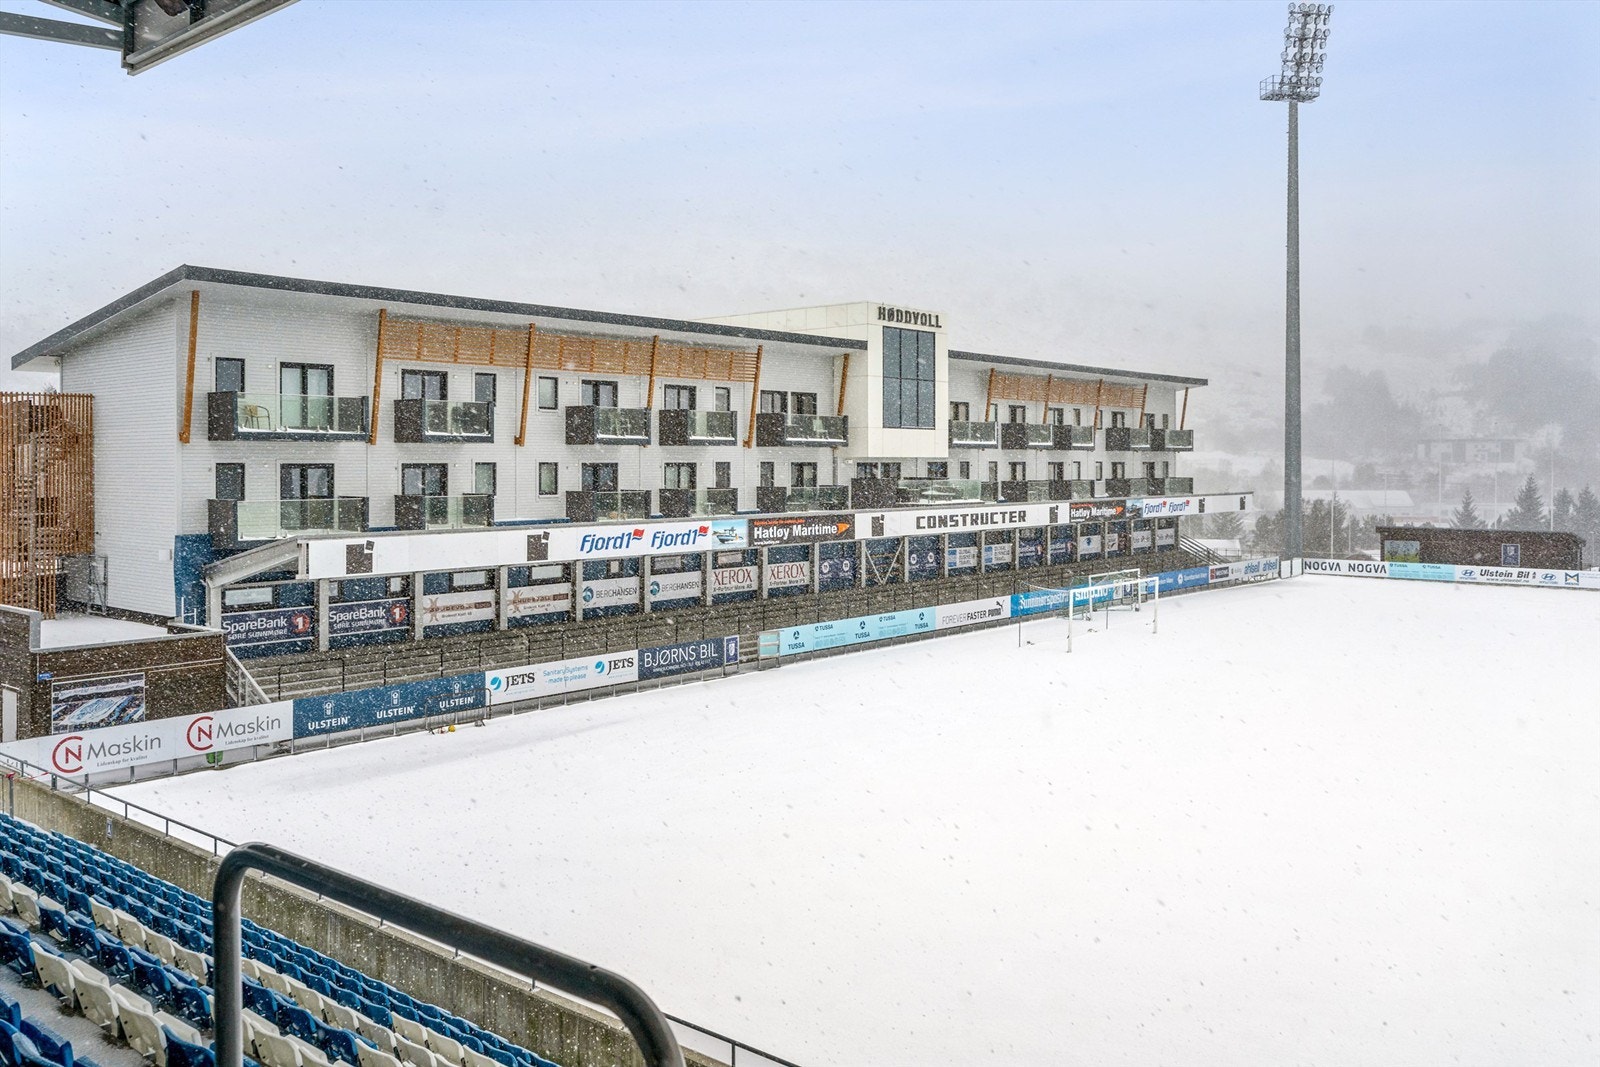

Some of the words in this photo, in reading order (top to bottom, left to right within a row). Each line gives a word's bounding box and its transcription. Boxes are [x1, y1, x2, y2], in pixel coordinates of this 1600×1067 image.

[877, 306, 942, 328] HØDDVOLL
[916, 510, 1027, 530] CONSTRUCTER
[650, 528, 698, 550] Fjord1
[753, 525, 790, 540] Hatløy
[792, 523, 838, 537] Maritime
[579, 531, 632, 554] Fjord1
[769, 563, 806, 580] XEROX
[1304, 561, 1341, 572] NOGVA
[1348, 563, 1387, 574] NOGVA
[1479, 568, 1513, 579] Ulstein
[1516, 570, 1530, 579] Bil
[714, 568, 753, 586] XEROX
[661, 581, 700, 592] BERGHANSEN
[329, 607, 386, 623] SpareBank
[966, 610, 988, 621] FASTER
[222, 616, 288, 634] SpareBank
[644, 645, 696, 668] BJØRNS
[700, 642, 718, 659] BIL
[607, 657, 634, 675] JETS
[504, 672, 535, 692] JETS
[439, 696, 474, 709] ULSTEIN
[376, 707, 413, 719] ULSTEIN
[216, 715, 281, 739] Maskin
[308, 717, 349, 730] ULSTEIN
[87, 735, 161, 760] Maskin
